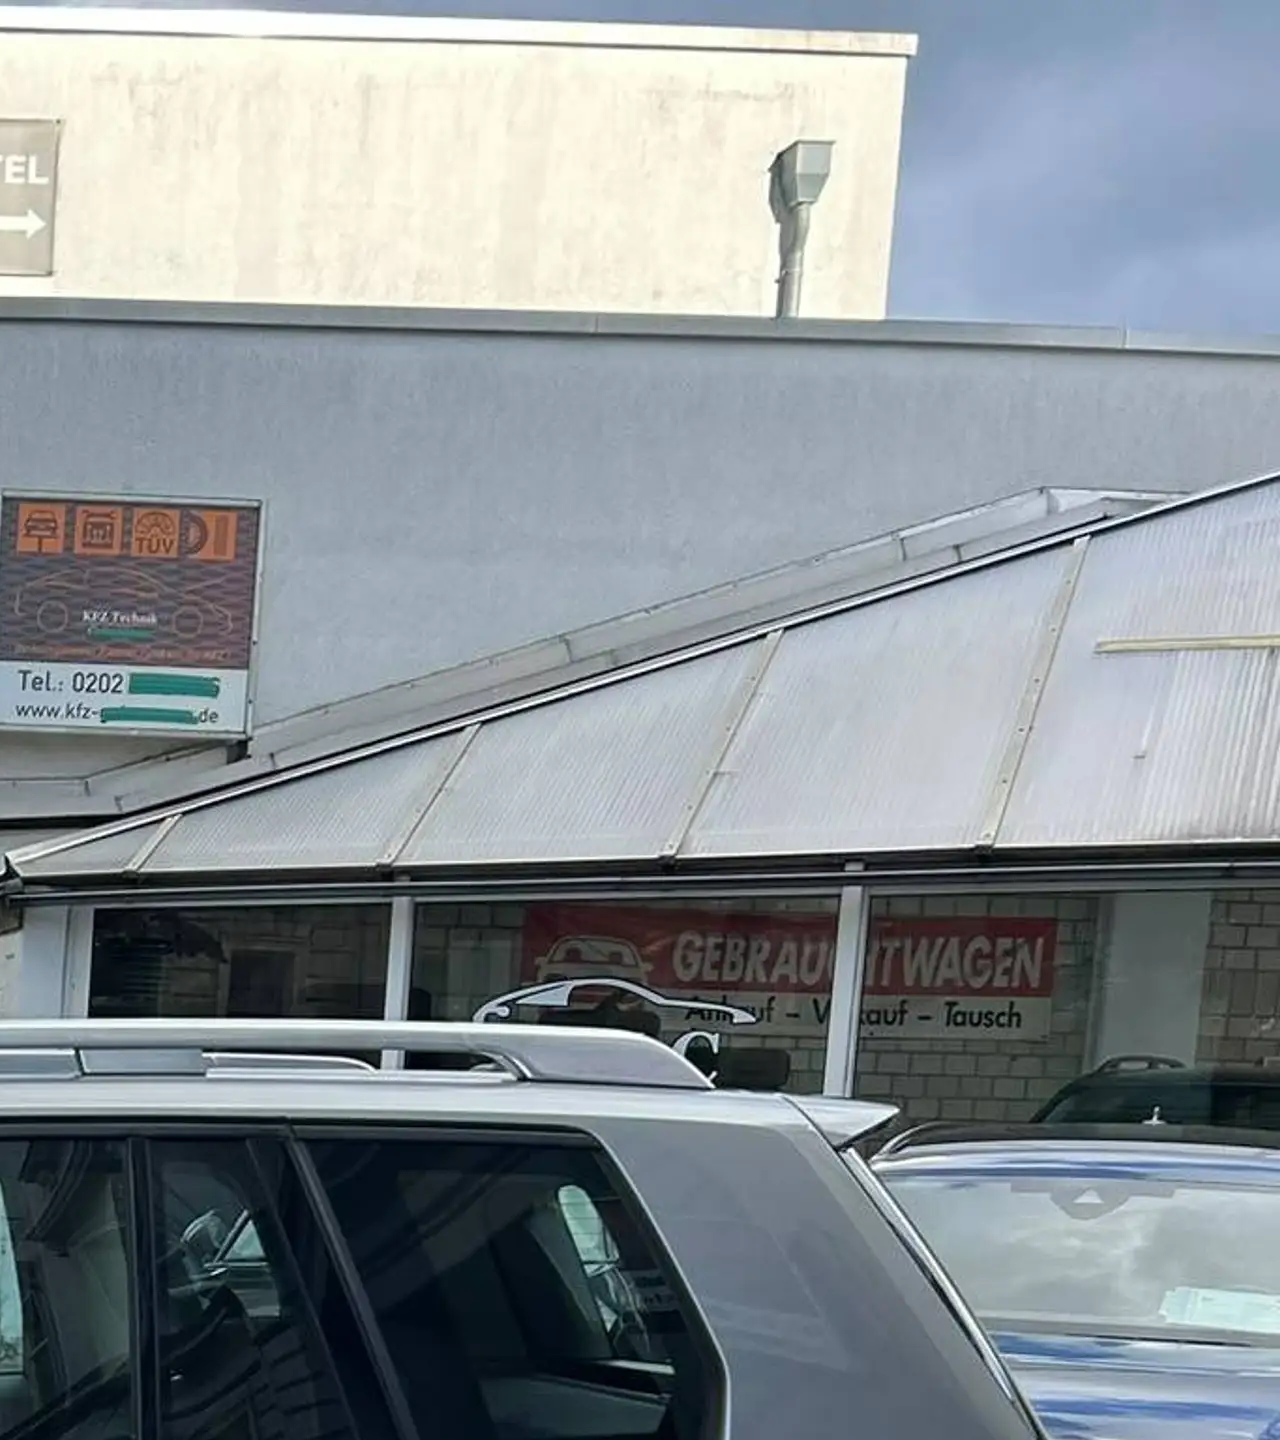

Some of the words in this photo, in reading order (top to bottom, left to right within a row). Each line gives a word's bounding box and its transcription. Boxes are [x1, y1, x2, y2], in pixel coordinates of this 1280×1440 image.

[136, 535, 175, 554] TÜV
[18, 669, 64, 692] Tel.:
[72, 671, 124, 694] 0202
[945, 1001, 1022, 1029] Tausch
